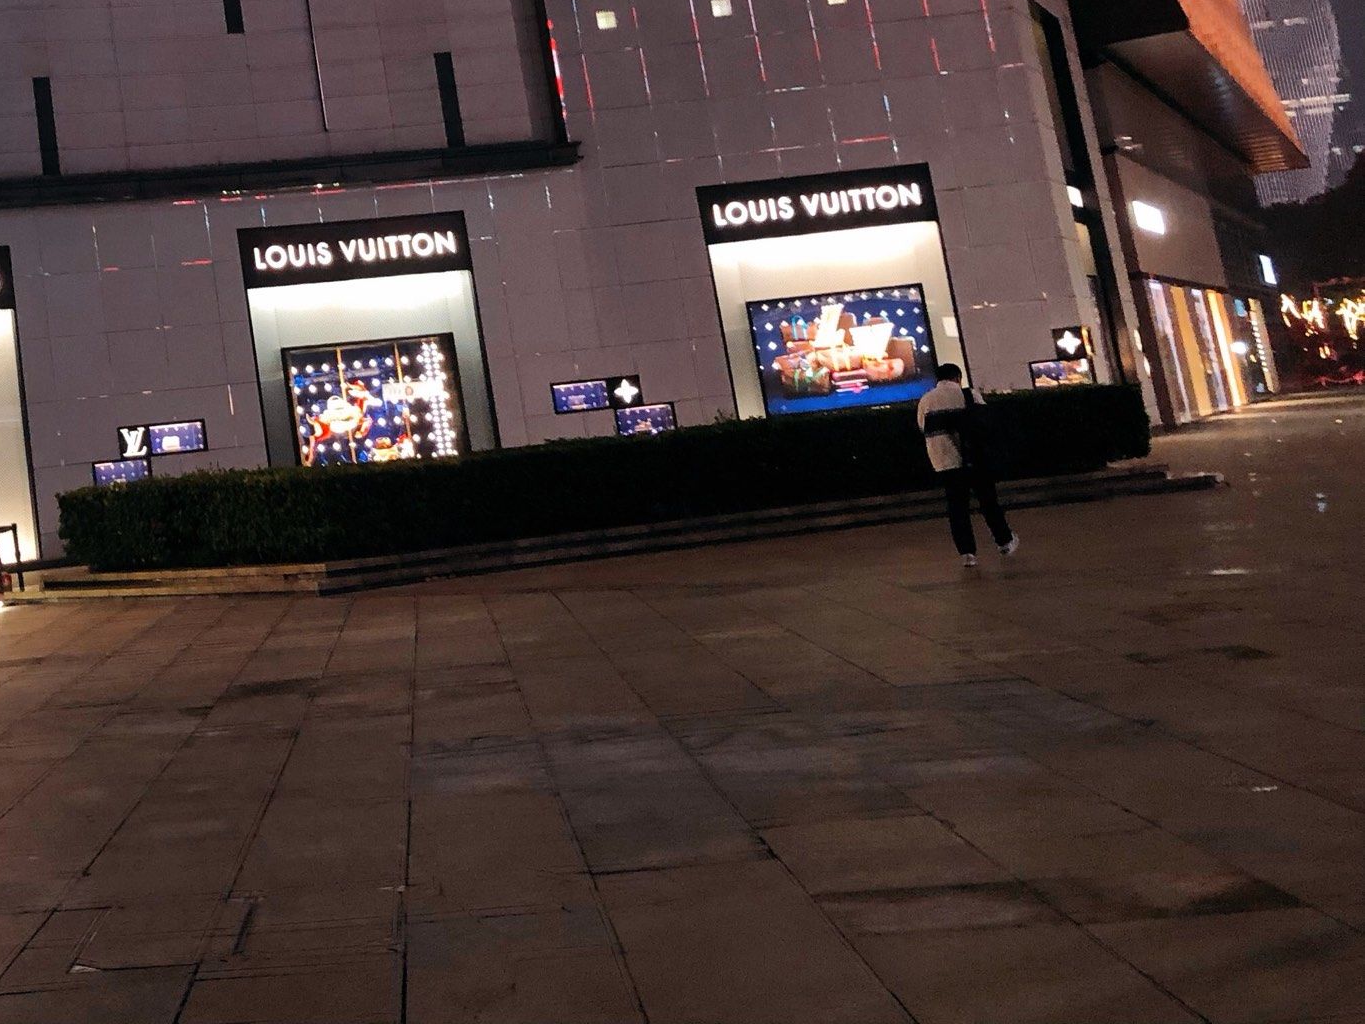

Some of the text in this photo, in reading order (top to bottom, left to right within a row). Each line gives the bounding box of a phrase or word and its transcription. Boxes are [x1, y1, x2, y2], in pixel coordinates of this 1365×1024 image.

[712, 182, 923, 228] LOUIS VUITTON
[253, 230, 458, 270] LOUIS VUITTON
